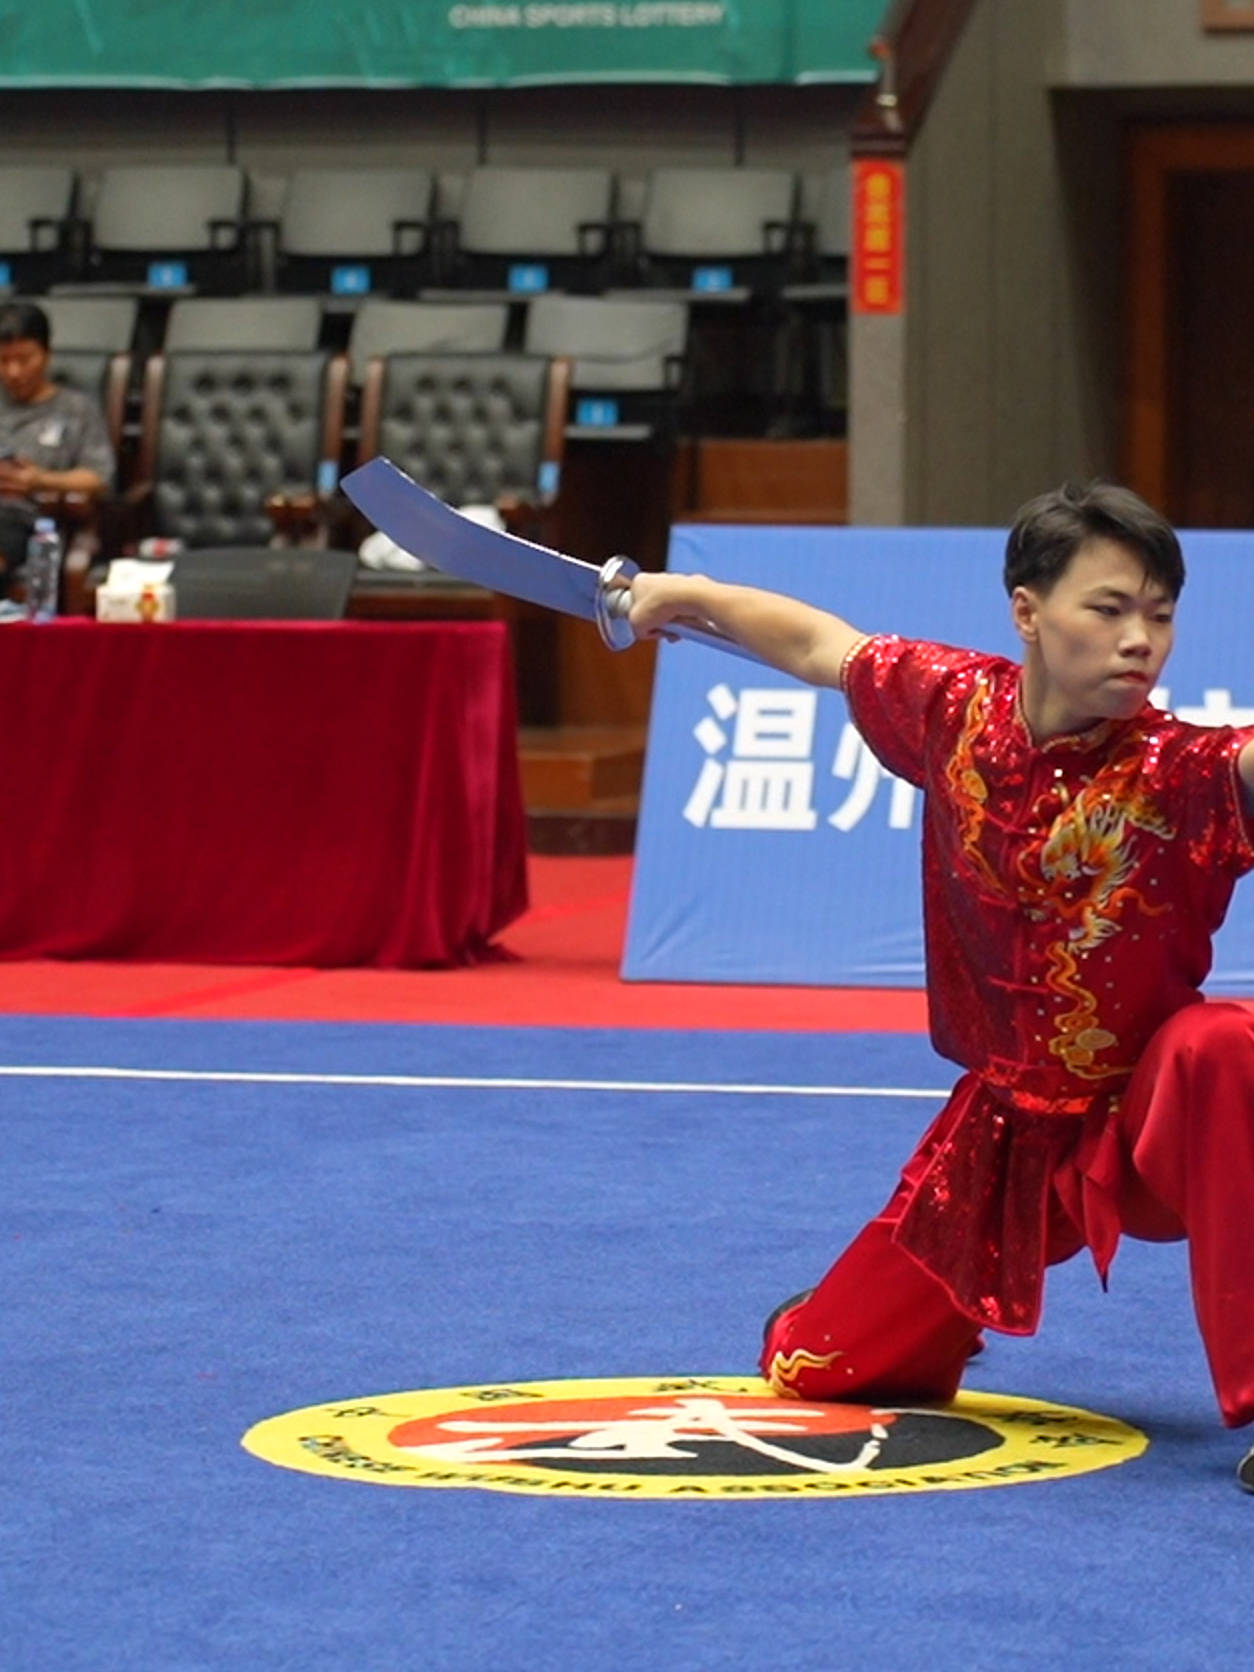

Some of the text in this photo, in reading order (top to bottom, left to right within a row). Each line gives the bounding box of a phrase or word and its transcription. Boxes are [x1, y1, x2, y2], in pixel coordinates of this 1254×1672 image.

[448, 2, 724, 29] CHINA SPORTS LOTTERY
